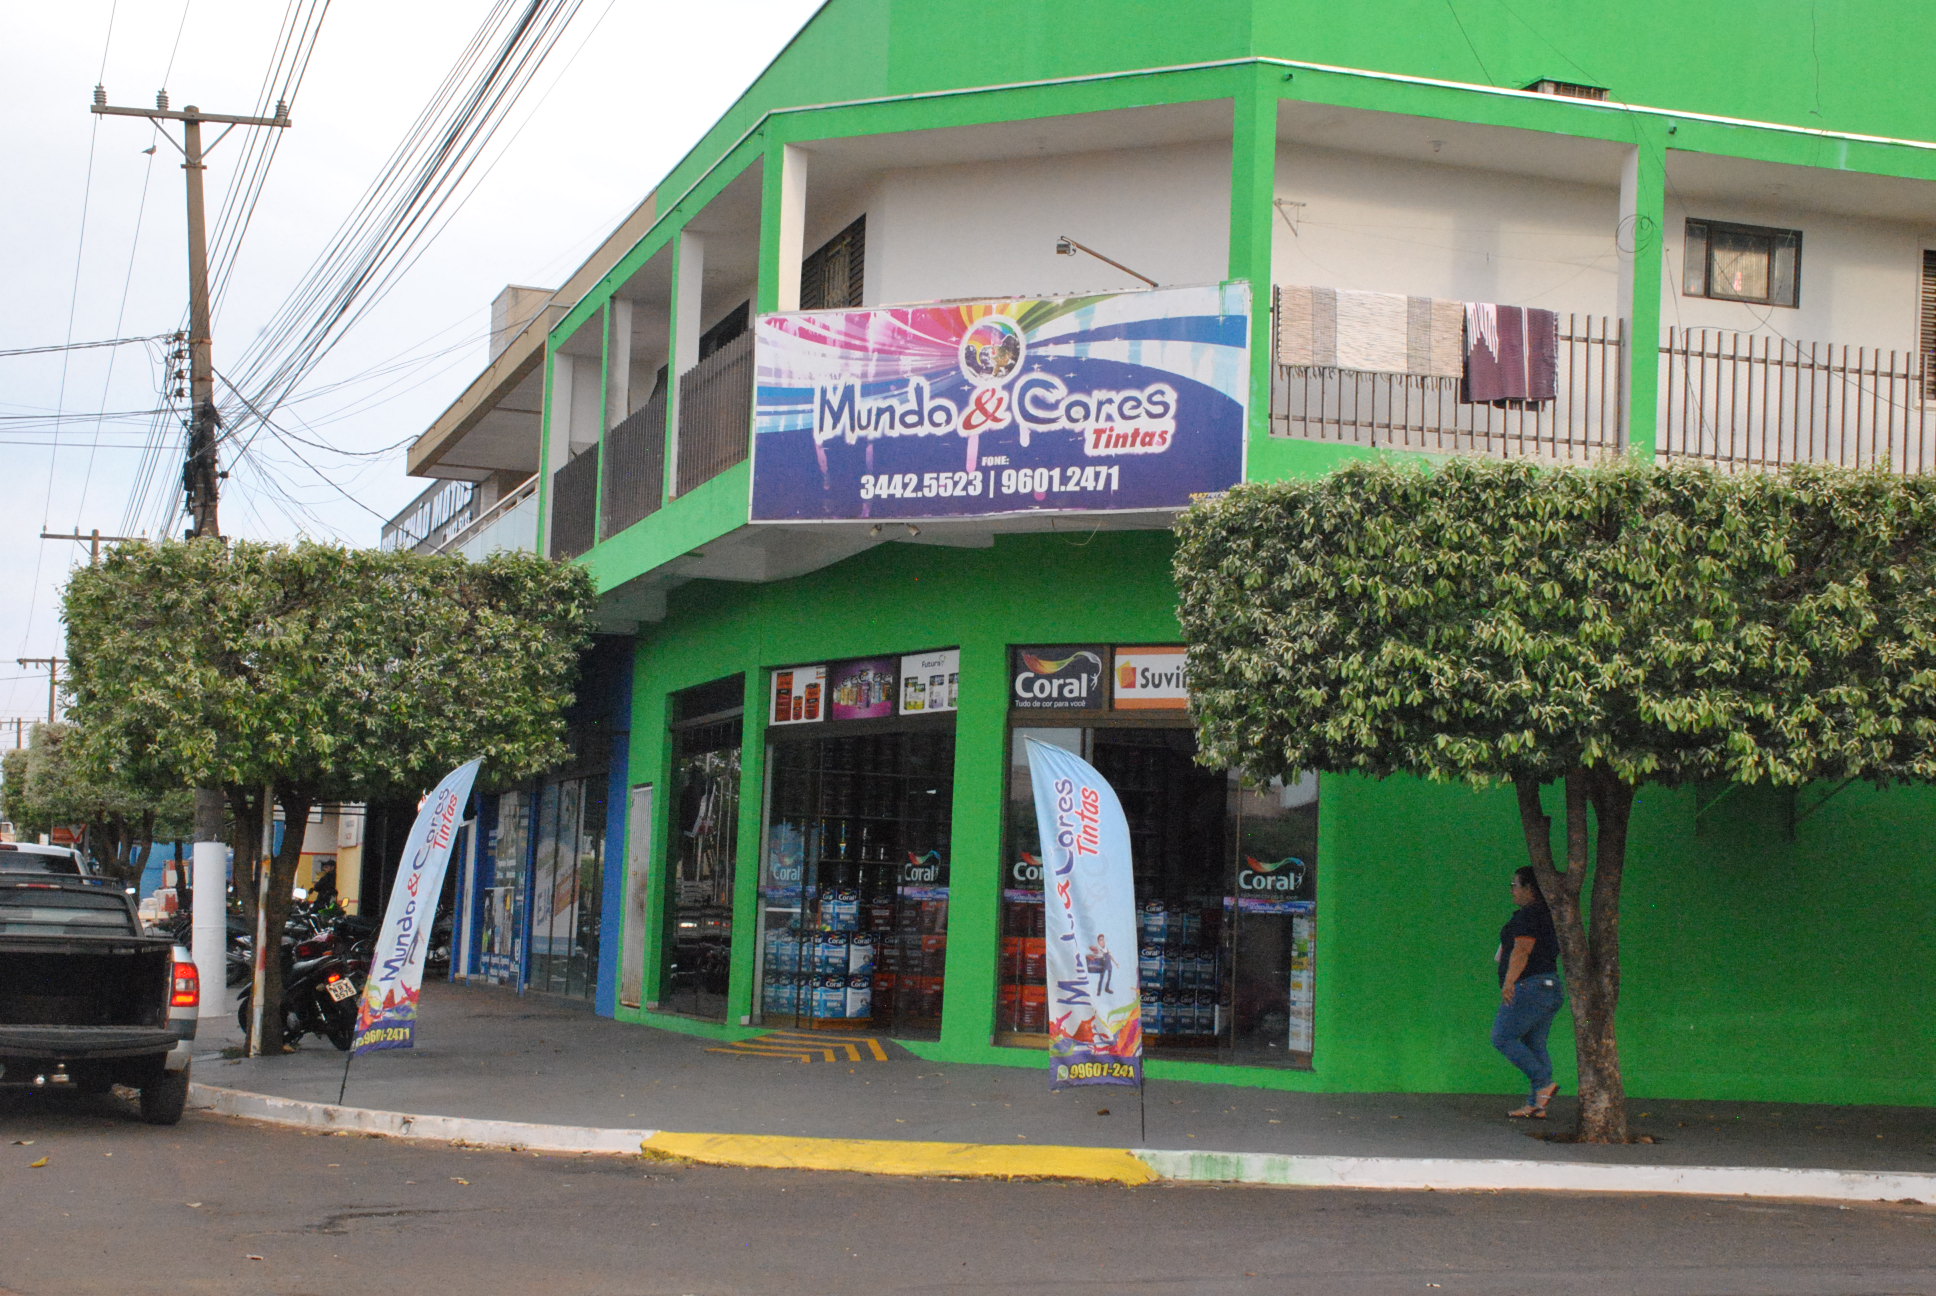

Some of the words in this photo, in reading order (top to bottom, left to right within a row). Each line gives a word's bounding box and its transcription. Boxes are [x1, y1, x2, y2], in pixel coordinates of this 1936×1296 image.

[819, 381, 953, 434] Mundo
[962, 387, 1006, 431] &
[1017, 378, 1171, 425] Cores
[1092, 425, 1169, 450] Tintas
[981, 455, 1010, 467] FONE:
[860, 470, 983, 500] 3442.5523
[1001, 465, 1120, 495] 9601.2471
[1015, 671, 1088, 698] Coral
[432, 794, 458, 850] Tintas
[1075, 786, 1099, 856] Tintas
[379, 900, 416, 981] Mundo
[412, 788, 450, 871] Cores
[904, 863, 935, 882] Coral
[1239, 869, 1295, 891] Coral
